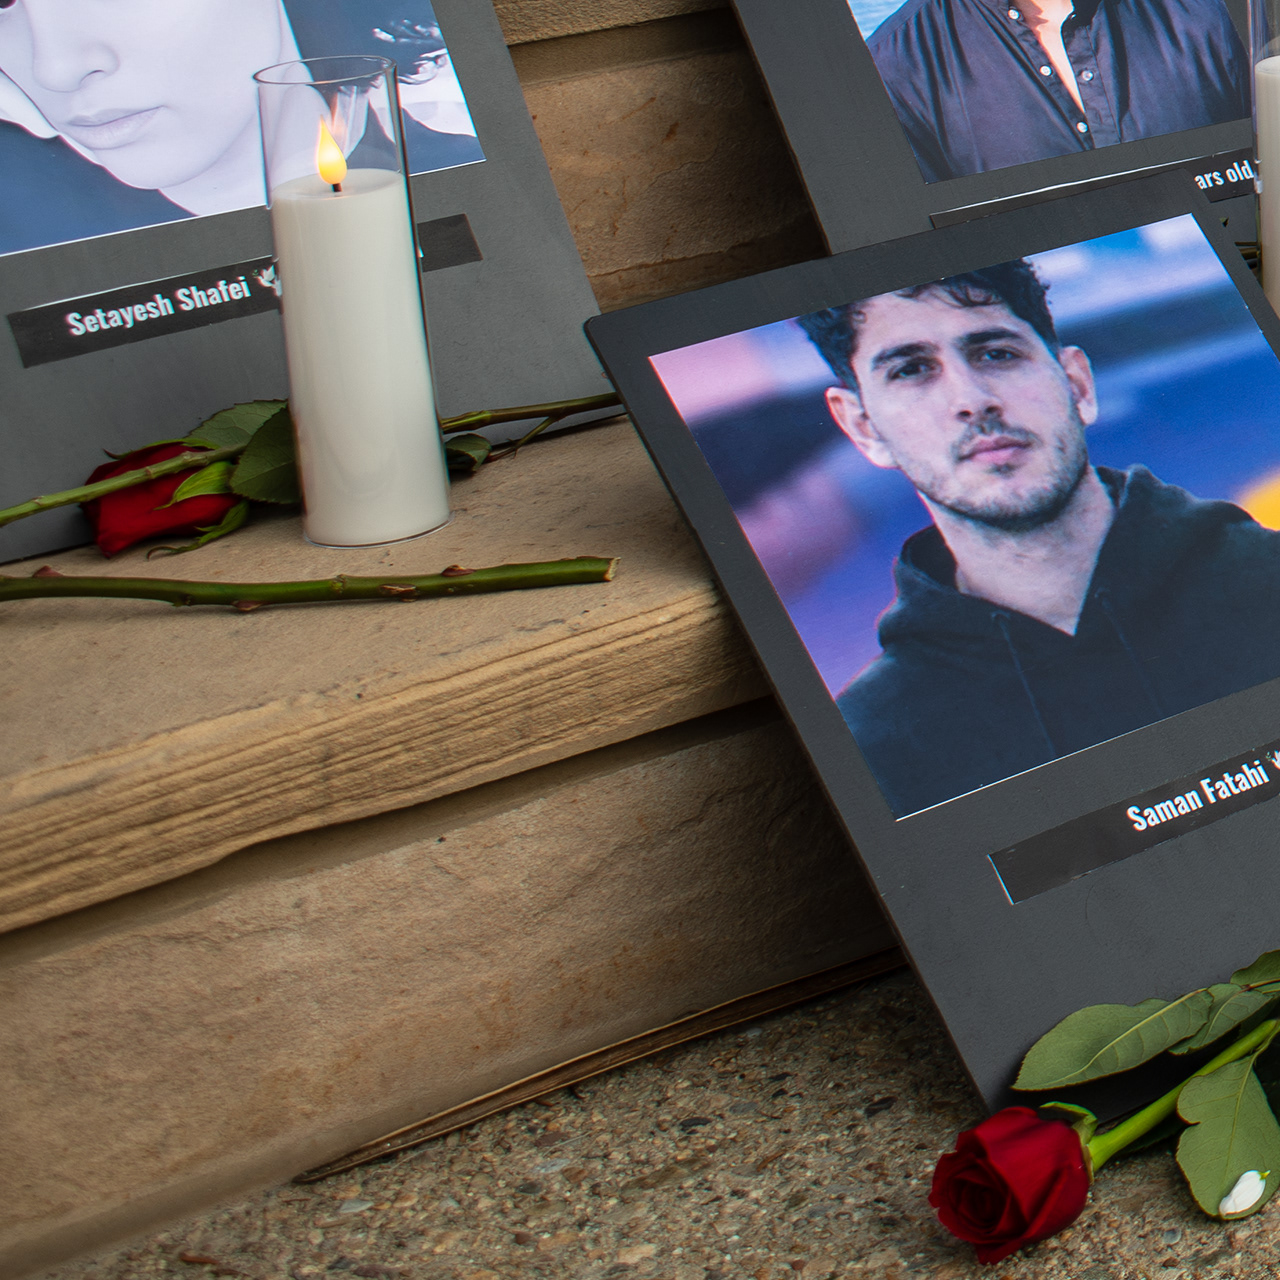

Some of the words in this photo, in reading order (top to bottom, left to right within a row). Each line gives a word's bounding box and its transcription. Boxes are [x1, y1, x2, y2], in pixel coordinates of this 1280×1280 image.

[1194, 170, 1225, 190] ars
[1225, 159, 1255, 183] old
[66, 293, 175, 336] Setayesh
[175, 275, 252, 312] Shafei
[1126, 788, 1204, 832] Saman
[1200, 759, 1271, 804] Fatahi
